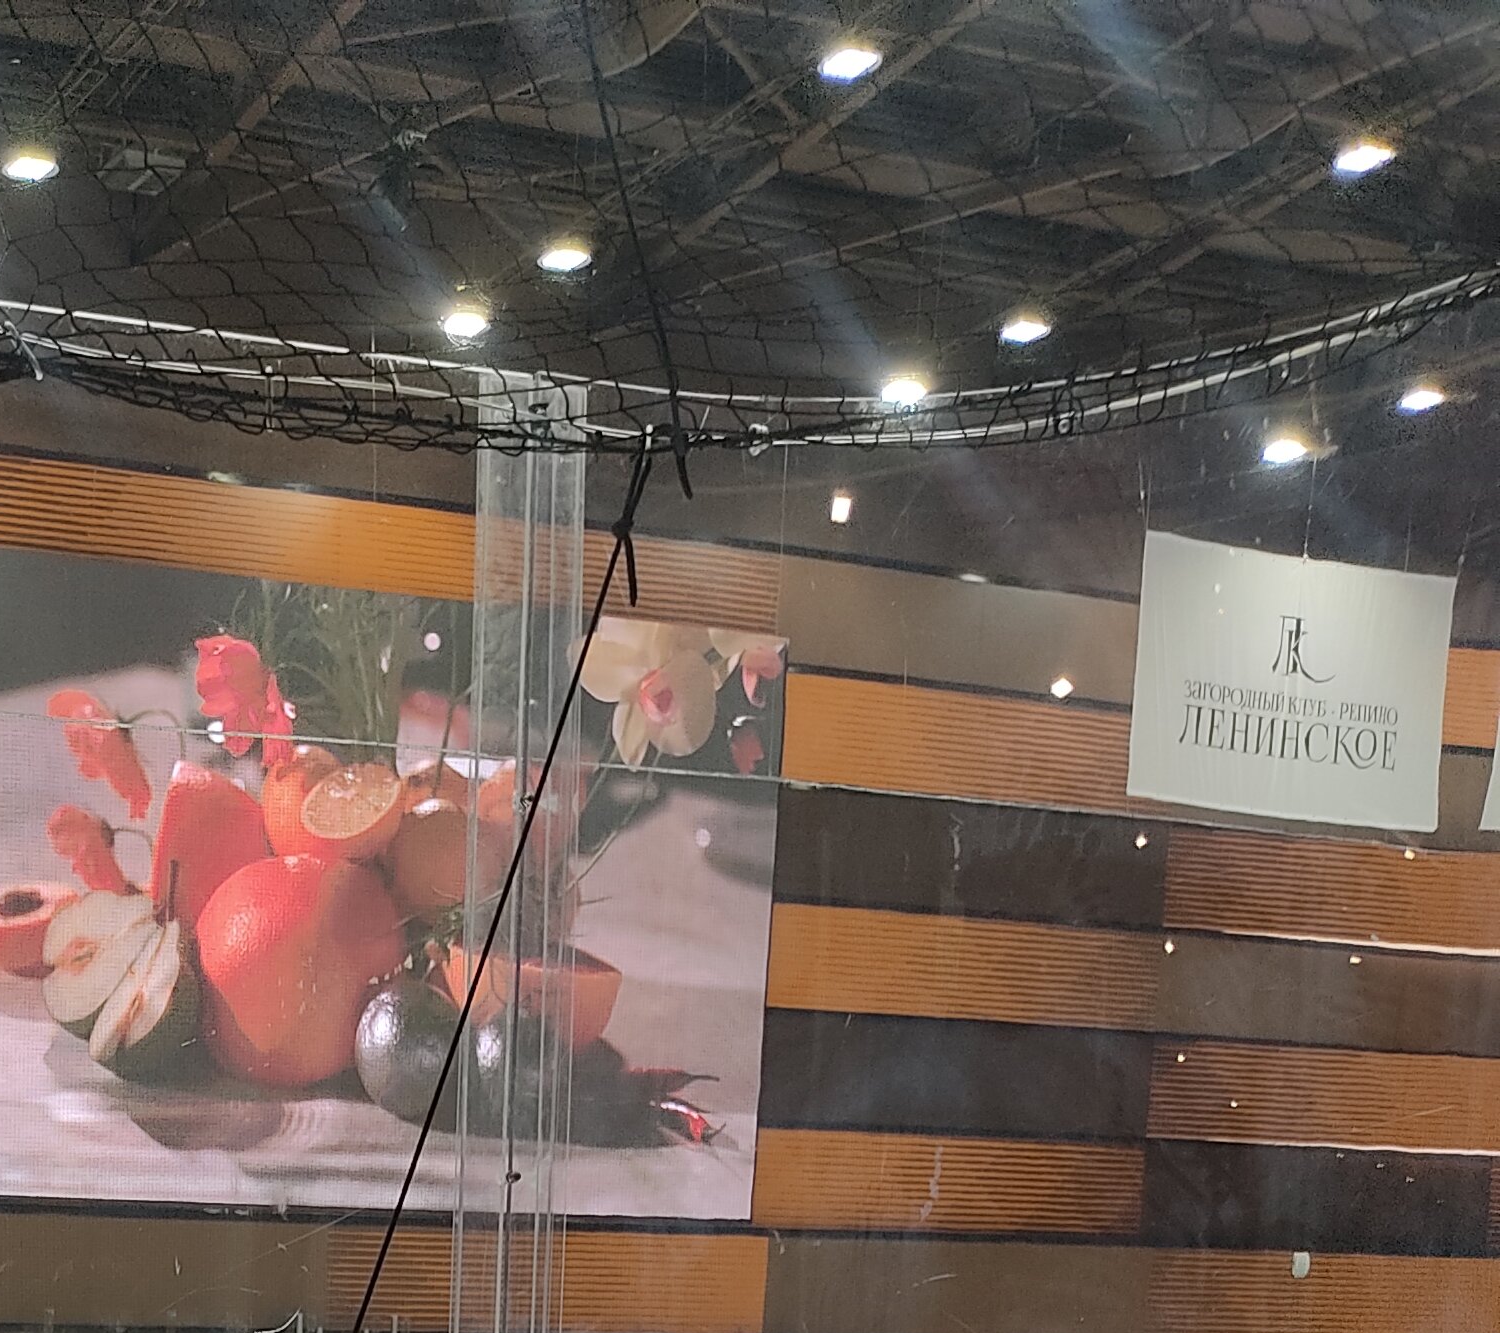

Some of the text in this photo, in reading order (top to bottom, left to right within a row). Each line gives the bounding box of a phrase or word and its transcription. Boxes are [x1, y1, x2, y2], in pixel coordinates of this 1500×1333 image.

[1287, 694, 1328, 718] КЛУБ
[1339, 701, 1399, 726] РЕПИНО
[1178, 703, 1398, 772] ЛЕНИНСКОЕ
